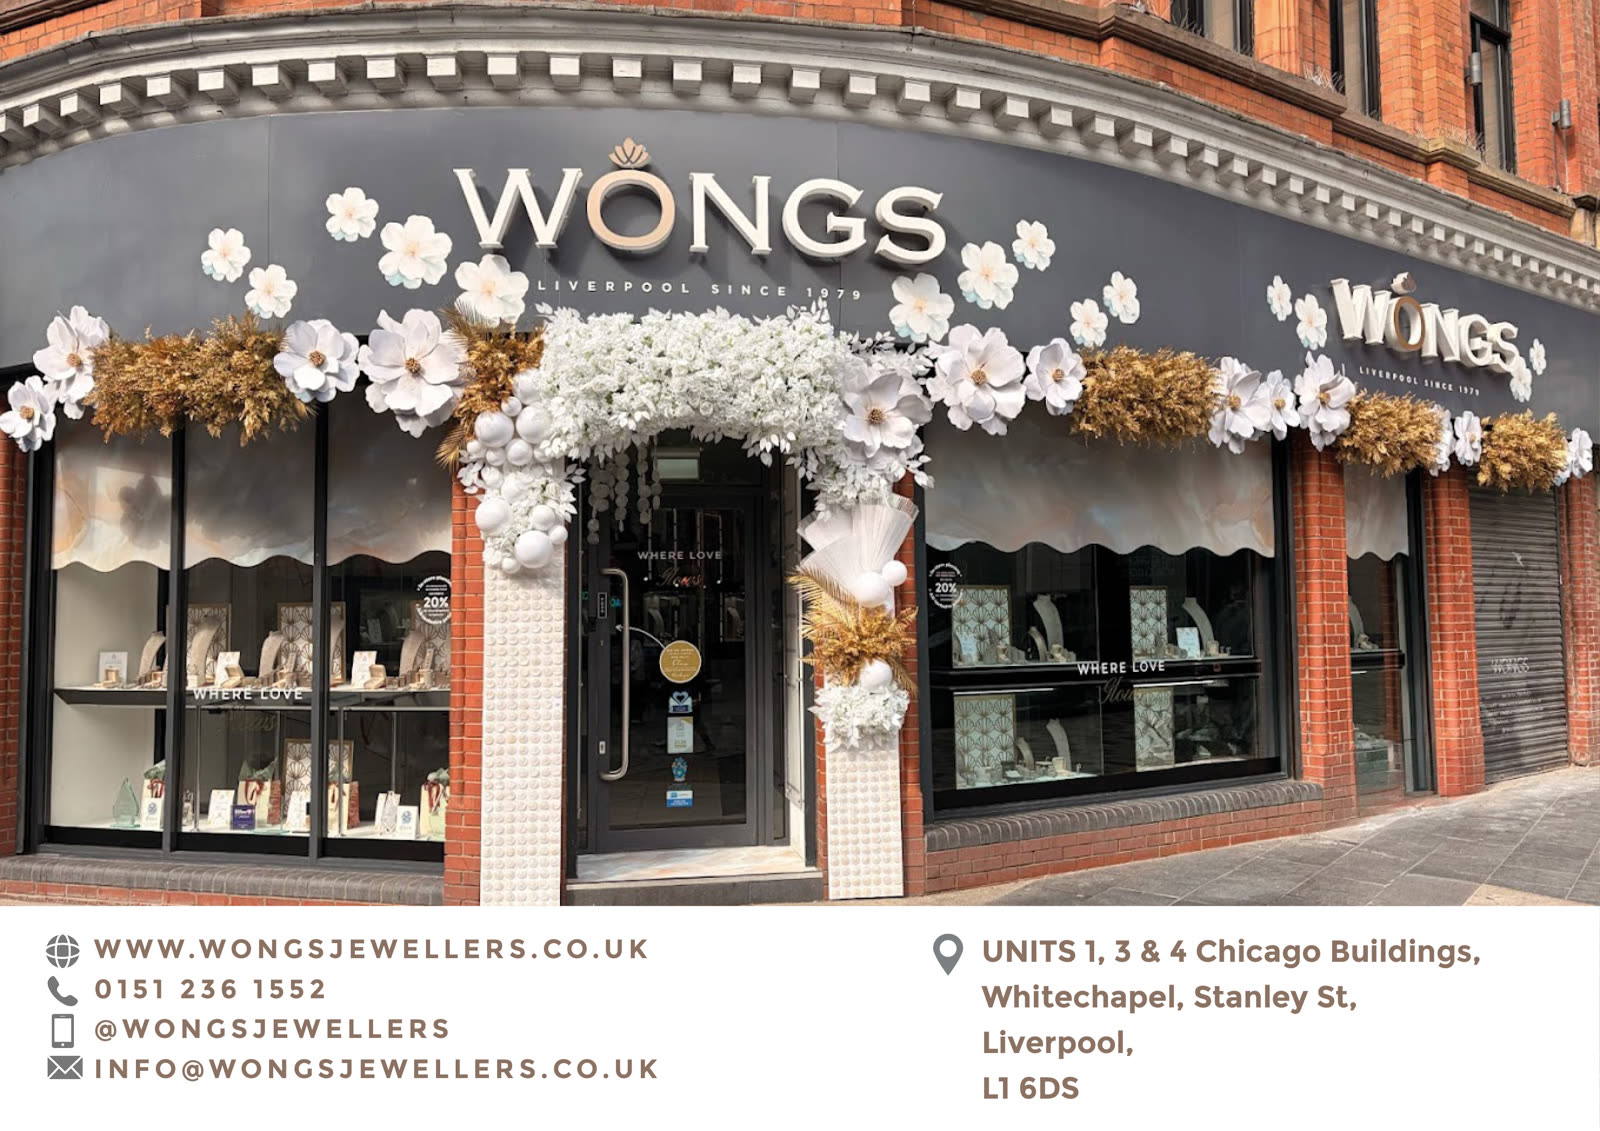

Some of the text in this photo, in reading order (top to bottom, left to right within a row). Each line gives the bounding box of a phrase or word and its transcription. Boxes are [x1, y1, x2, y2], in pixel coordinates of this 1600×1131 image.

[453, 168, 947, 265] WONGS
[537, 279, 863, 301] LIVERPOOL SINCE 1979
[1330, 277, 1520, 374] WONGS
[1359, 366, 1481, 397] LIVERPOOL SINCE 1979
[637, 551, 723, 560] WHERE LOVE
[934, 582, 957, 593] 20%
[423, 596, 449, 608] 20%
[1077, 660, 1165, 676] WHERE LOVE
[193, 688, 303, 700] WHERE LOVE
